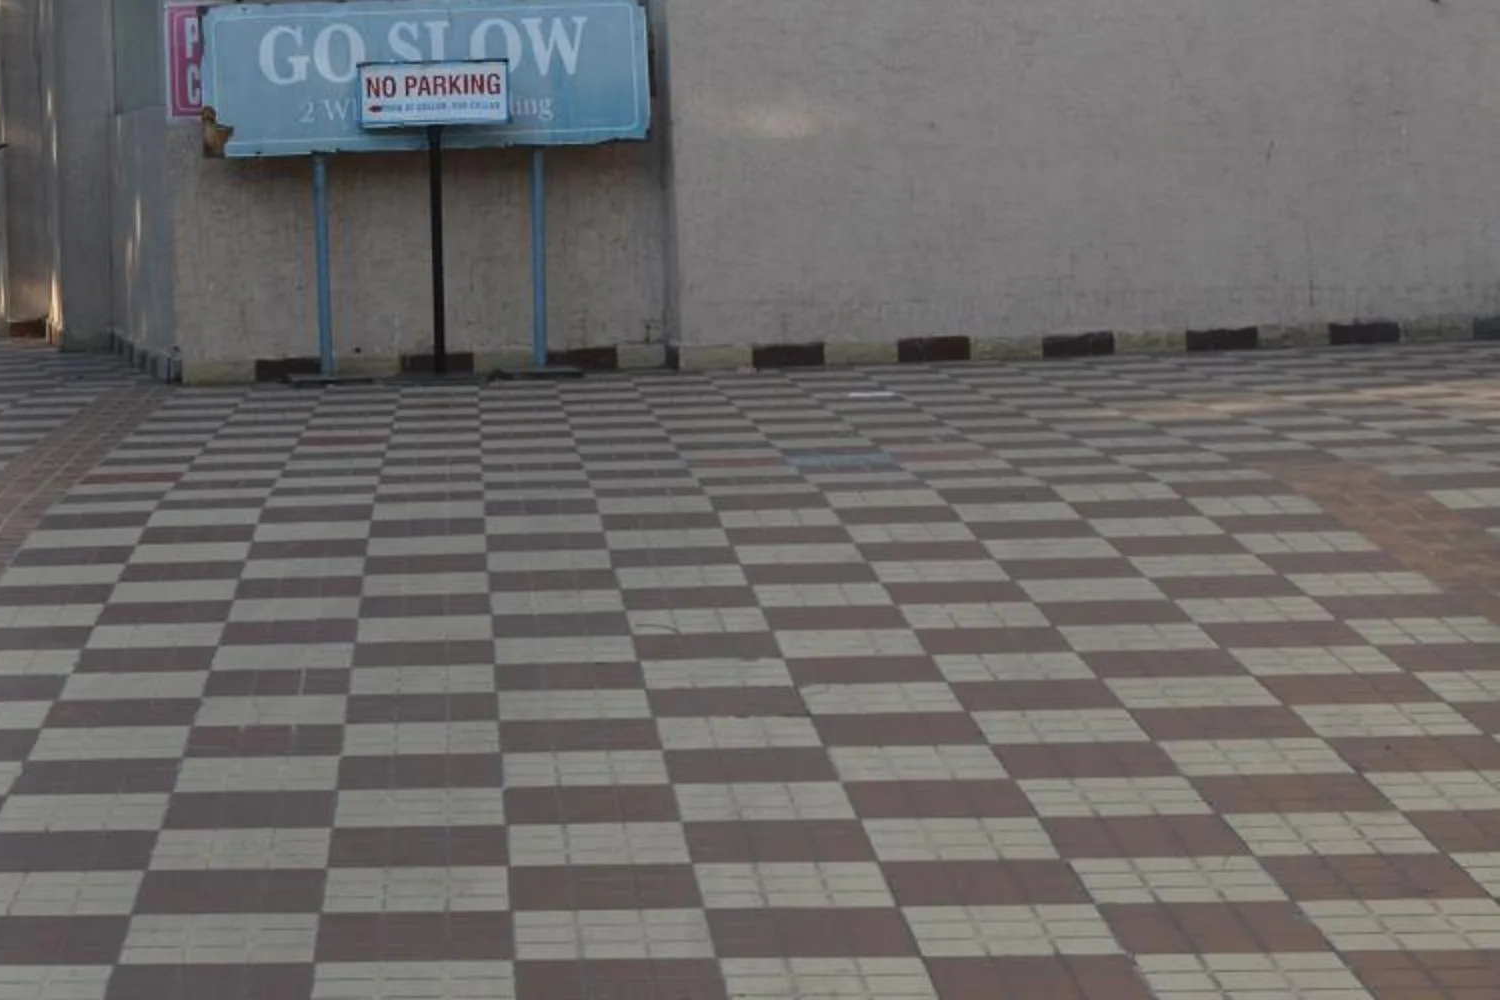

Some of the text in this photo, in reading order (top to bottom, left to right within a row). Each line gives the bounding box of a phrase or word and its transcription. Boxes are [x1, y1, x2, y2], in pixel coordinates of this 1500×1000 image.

[258, 24, 366, 86] GO
[366, 72, 501, 99] NO PARKING
